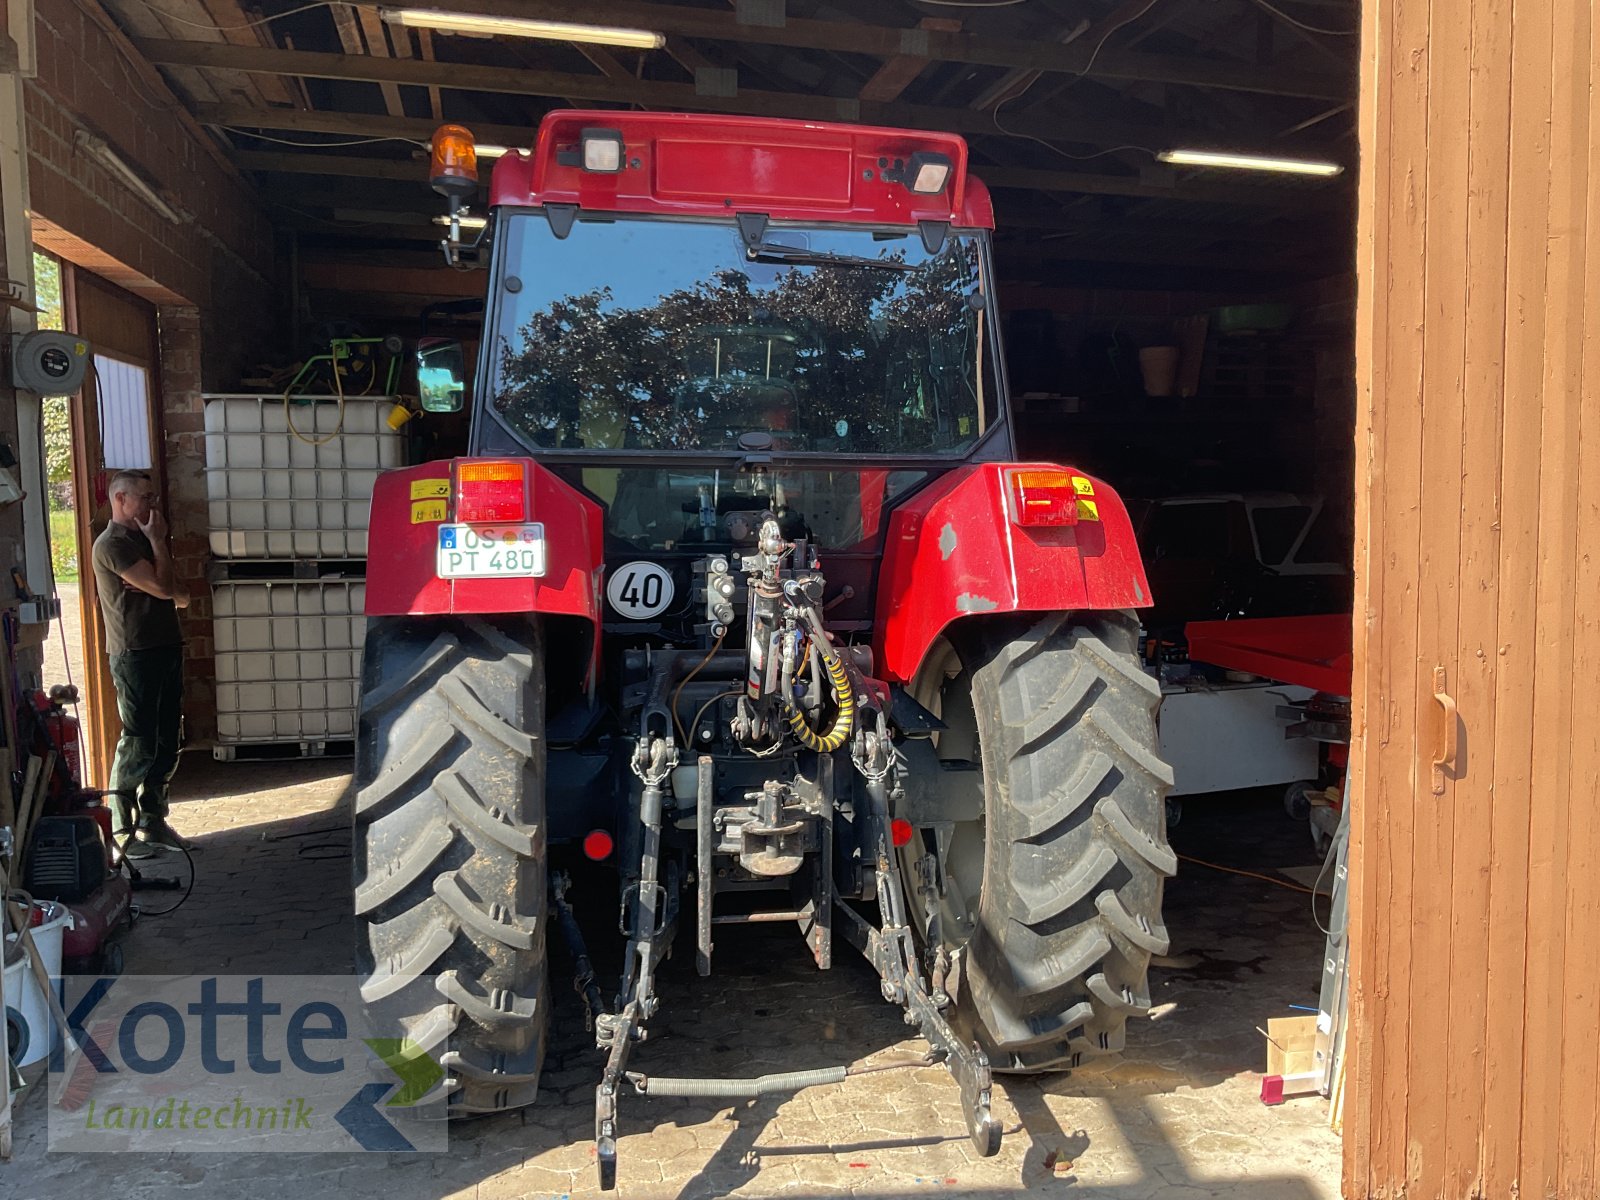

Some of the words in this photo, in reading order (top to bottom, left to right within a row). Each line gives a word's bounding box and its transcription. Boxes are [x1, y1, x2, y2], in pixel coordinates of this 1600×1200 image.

[445, 540, 453, 548] D
[465, 529, 496, 549] OS
[448, 551, 480, 572] PT
[489, 550, 534, 570] 480
[619, 572, 663, 608] 40
